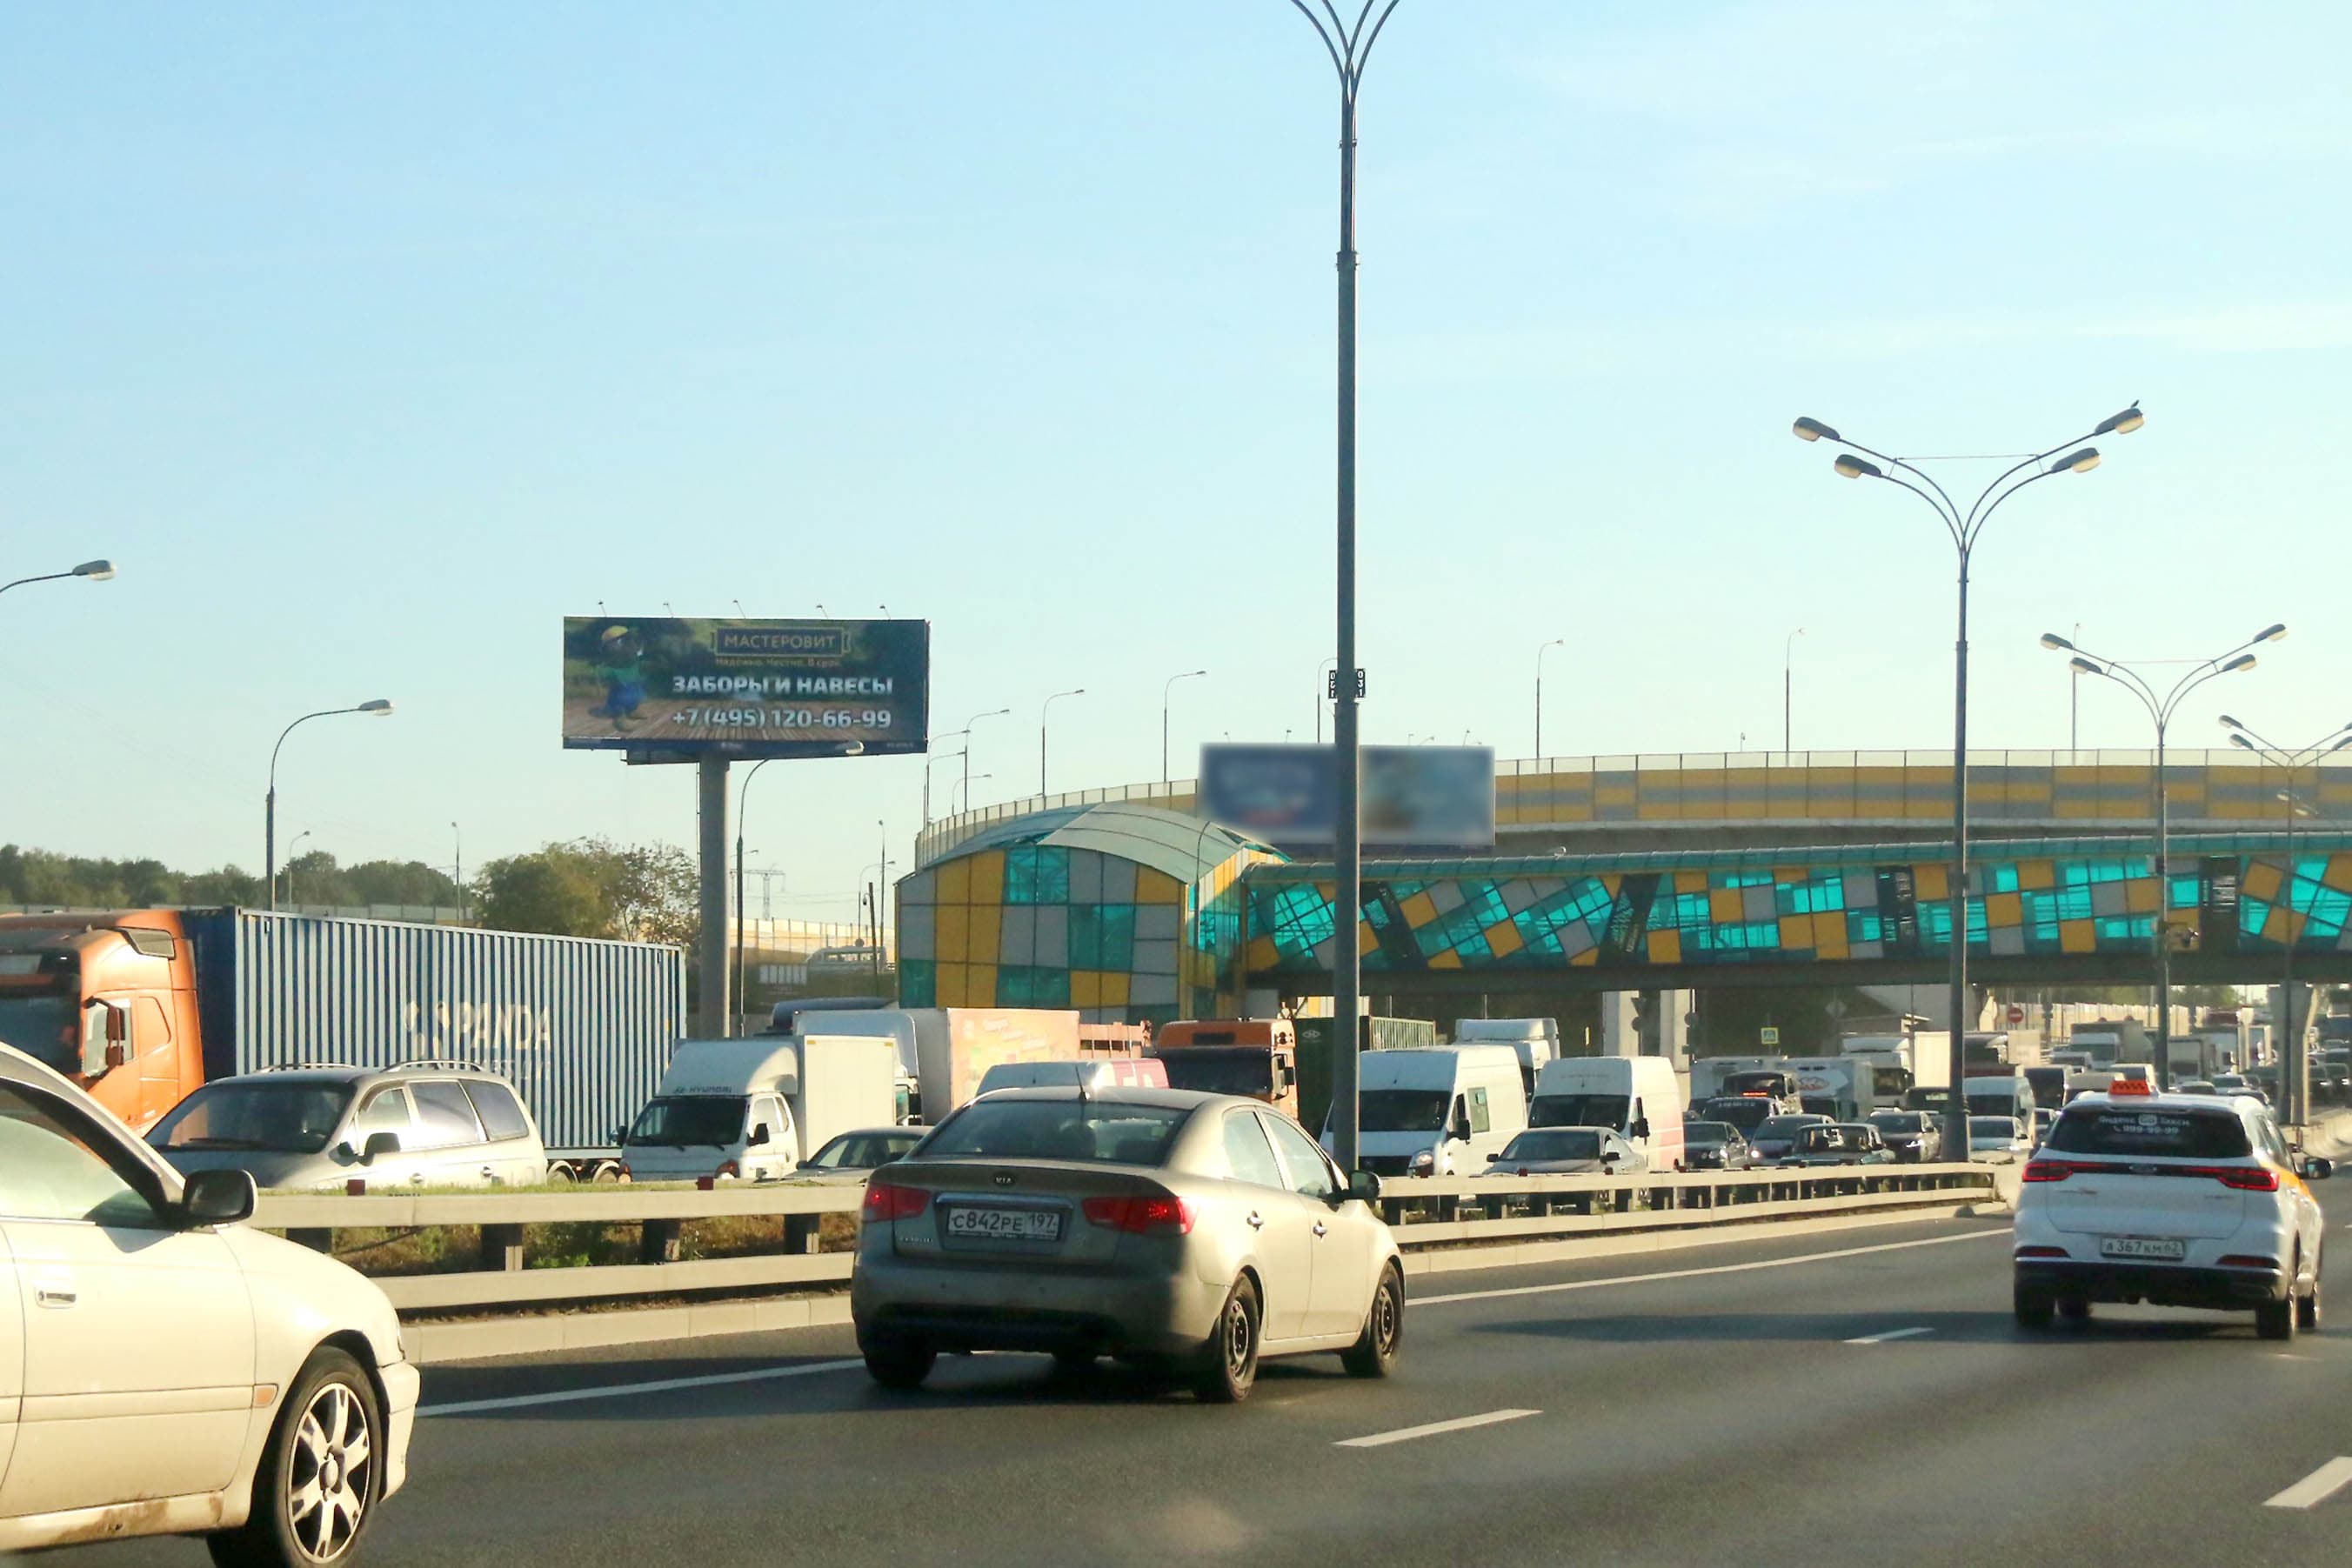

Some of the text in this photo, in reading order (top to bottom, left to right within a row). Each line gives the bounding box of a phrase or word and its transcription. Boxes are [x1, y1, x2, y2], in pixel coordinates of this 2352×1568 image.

[724, 634, 836, 650] МАСТЕРОВИТ
[672, 676, 894, 694] ЗАБОРЫ И НАВЕСЫ
[673, 709, 892, 729] +7 (495) 120-66-99
[457, 1000, 551, 1051] PANDA
[1029, 1213, 1054, 1229] 197
